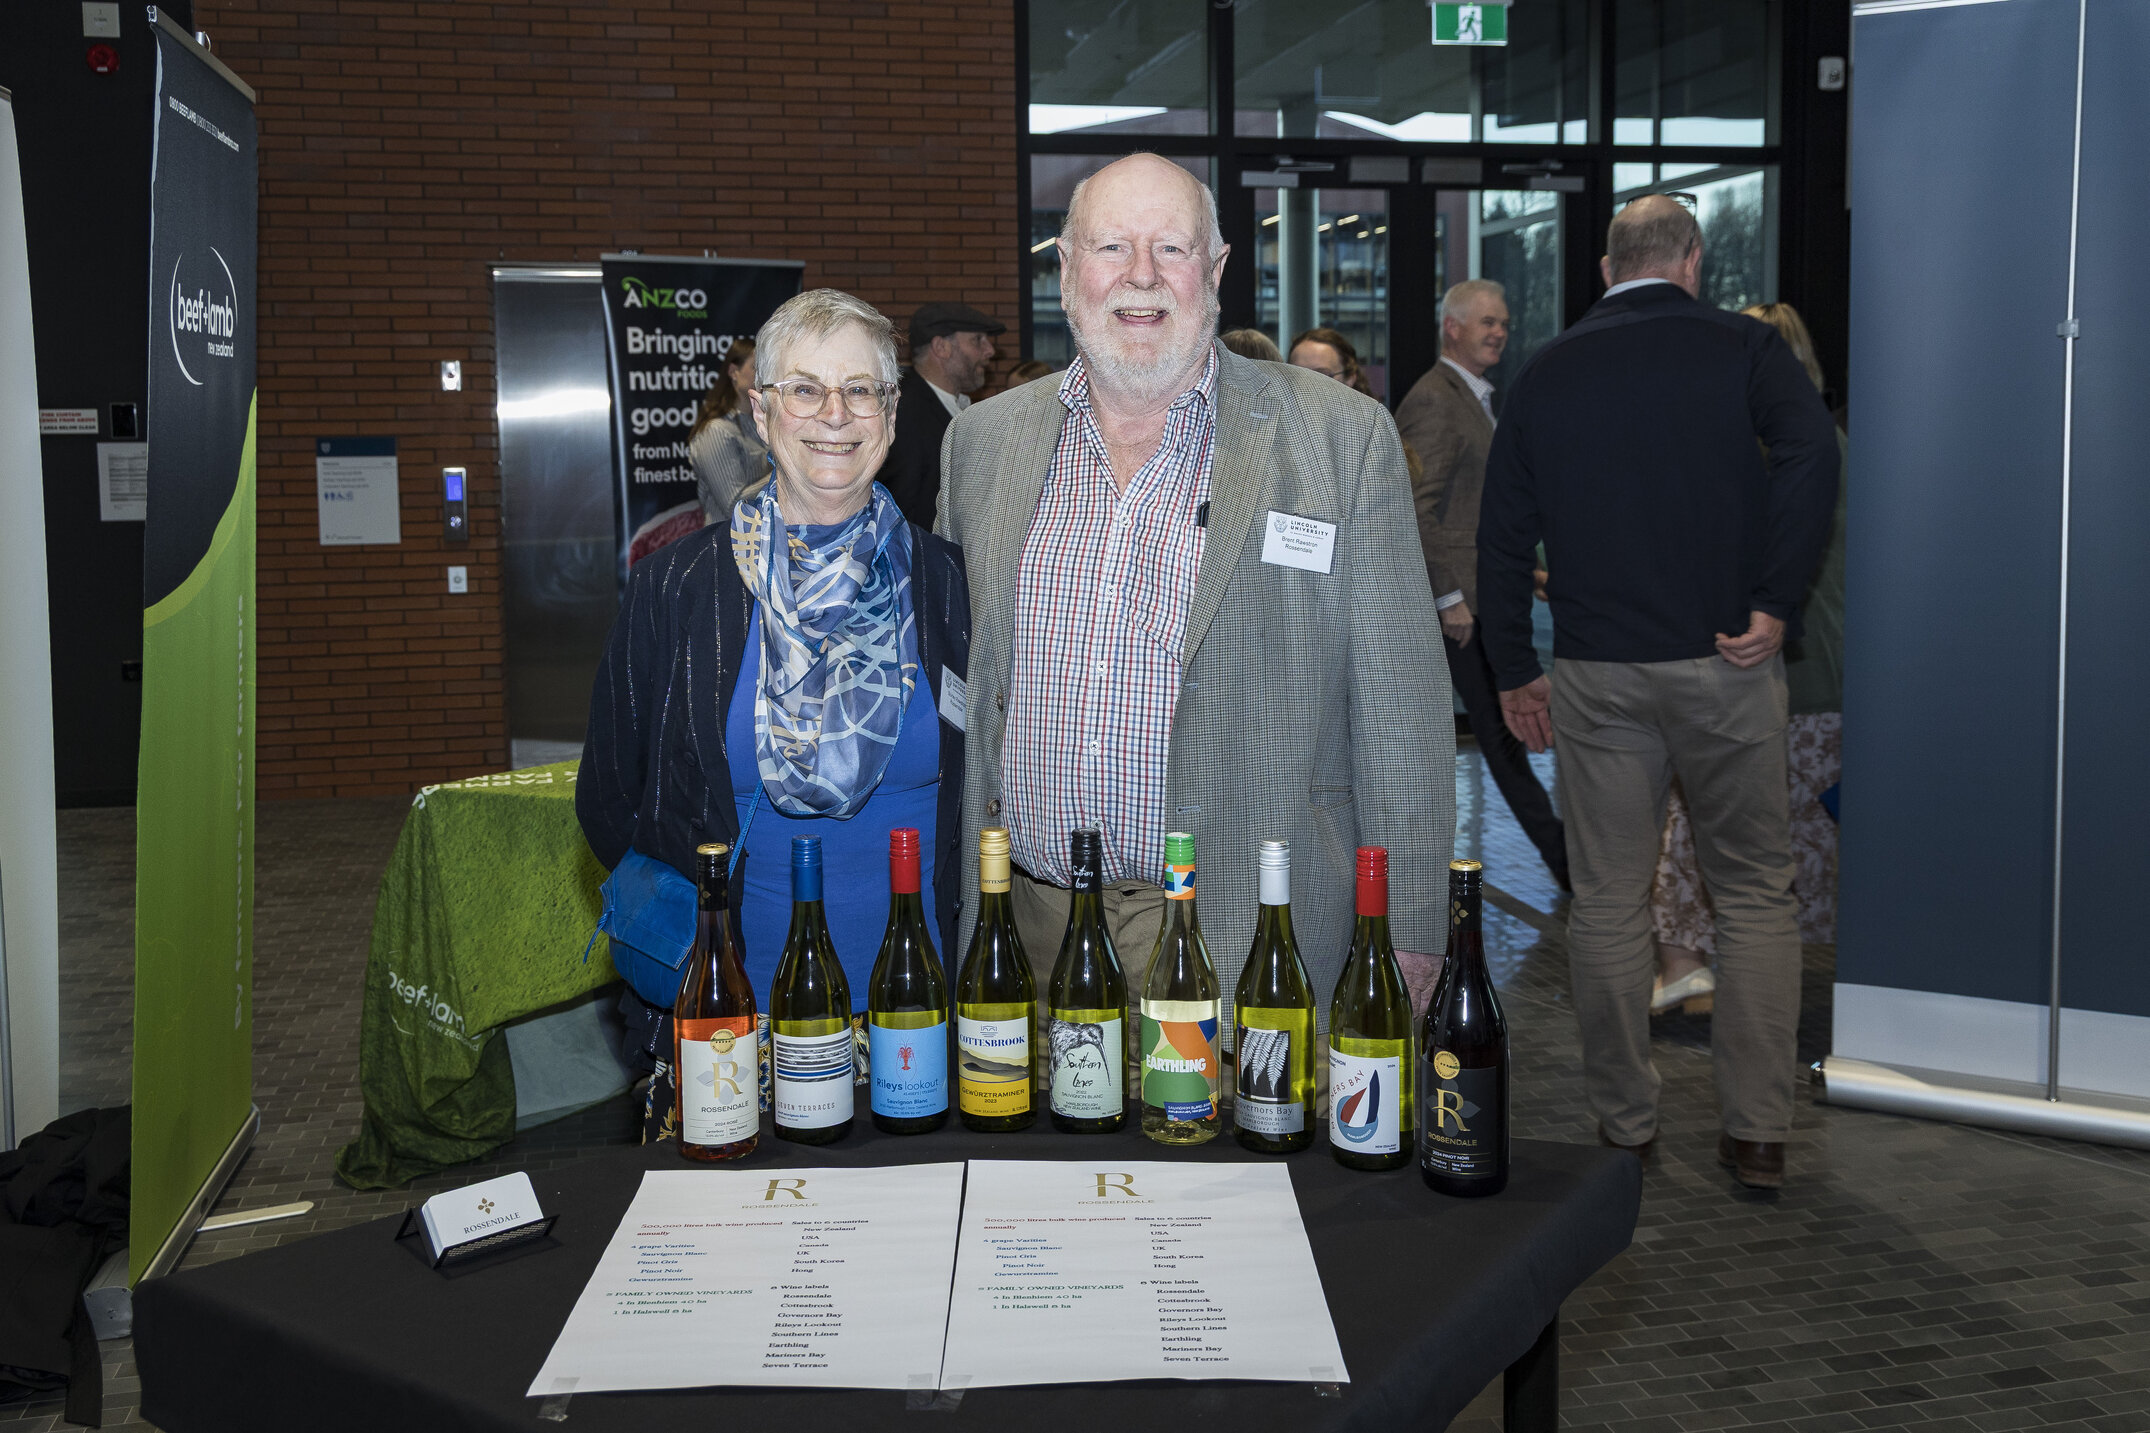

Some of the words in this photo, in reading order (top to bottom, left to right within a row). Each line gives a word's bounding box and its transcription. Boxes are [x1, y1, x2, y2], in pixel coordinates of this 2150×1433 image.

[622, 286, 708, 309] ANZCO
[178, 283, 234, 338] beef+lamb
[677, 310, 708, 318] FOODS
[215, 340, 233, 357] zealand
[627, 326, 733, 360] Bringing
[629, 366, 719, 392] nutritio
[631, 400, 698, 435] good
[632, 443, 670, 459] from
[634, 466, 678, 483] finest
[1291, 520, 1318, 529] LINCOLN
[1291, 526, 1328, 536] UNIVERSITY
[960, 1034, 1025, 1047] COTTESBROOK
[1064, 1052, 1101, 1070] Southern
[1146, 1054, 1206, 1073] EARTHLING
[712, 1060, 743, 1098] R
[876, 1078, 902, 1092] Rileys
[905, 1079, 938, 1090] lookout
[1348, 1070, 1364, 1086] BAY
[962, 1086, 1024, 1098] GEWÜRZTRAMINER
[702, 1100, 749, 1113] ROSSENDALE
[798, 1102, 835, 1112] TERRACES
[1277, 1107, 1292, 1115] Bay
[1432, 1088, 1470, 1131] R
[1243, 1117, 1280, 1126] MARLBOROUGH
[1428, 1132, 1477, 1146] ROSSENDALE
[754, 1178, 811, 1201] R
[1086, 1173, 1143, 1198] R
[464, 1212, 520, 1234] ROSSENDALE
